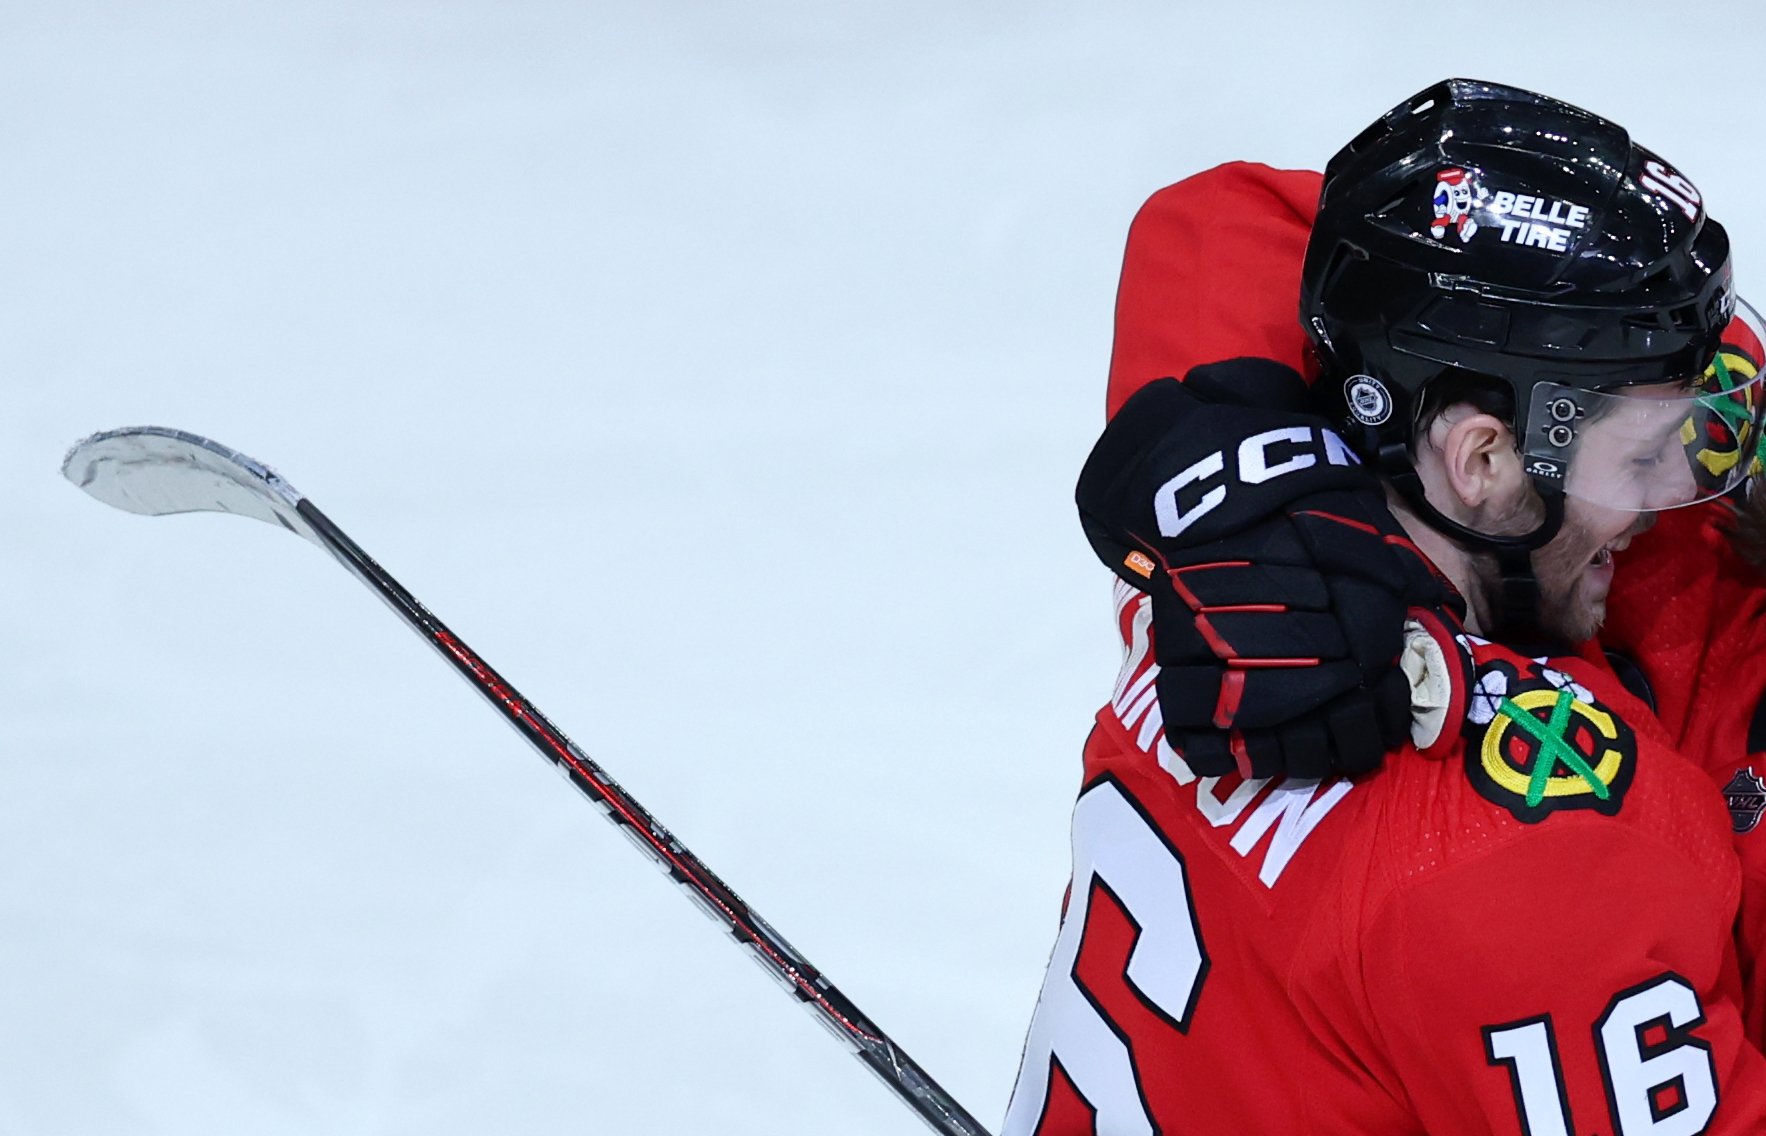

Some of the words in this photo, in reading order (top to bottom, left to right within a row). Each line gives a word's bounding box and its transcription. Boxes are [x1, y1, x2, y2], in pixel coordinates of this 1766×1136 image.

[1492, 191, 1589, 228] BELLE
[1640, 160, 1702, 222] 16
[1500, 219, 1571, 252] TIRE
